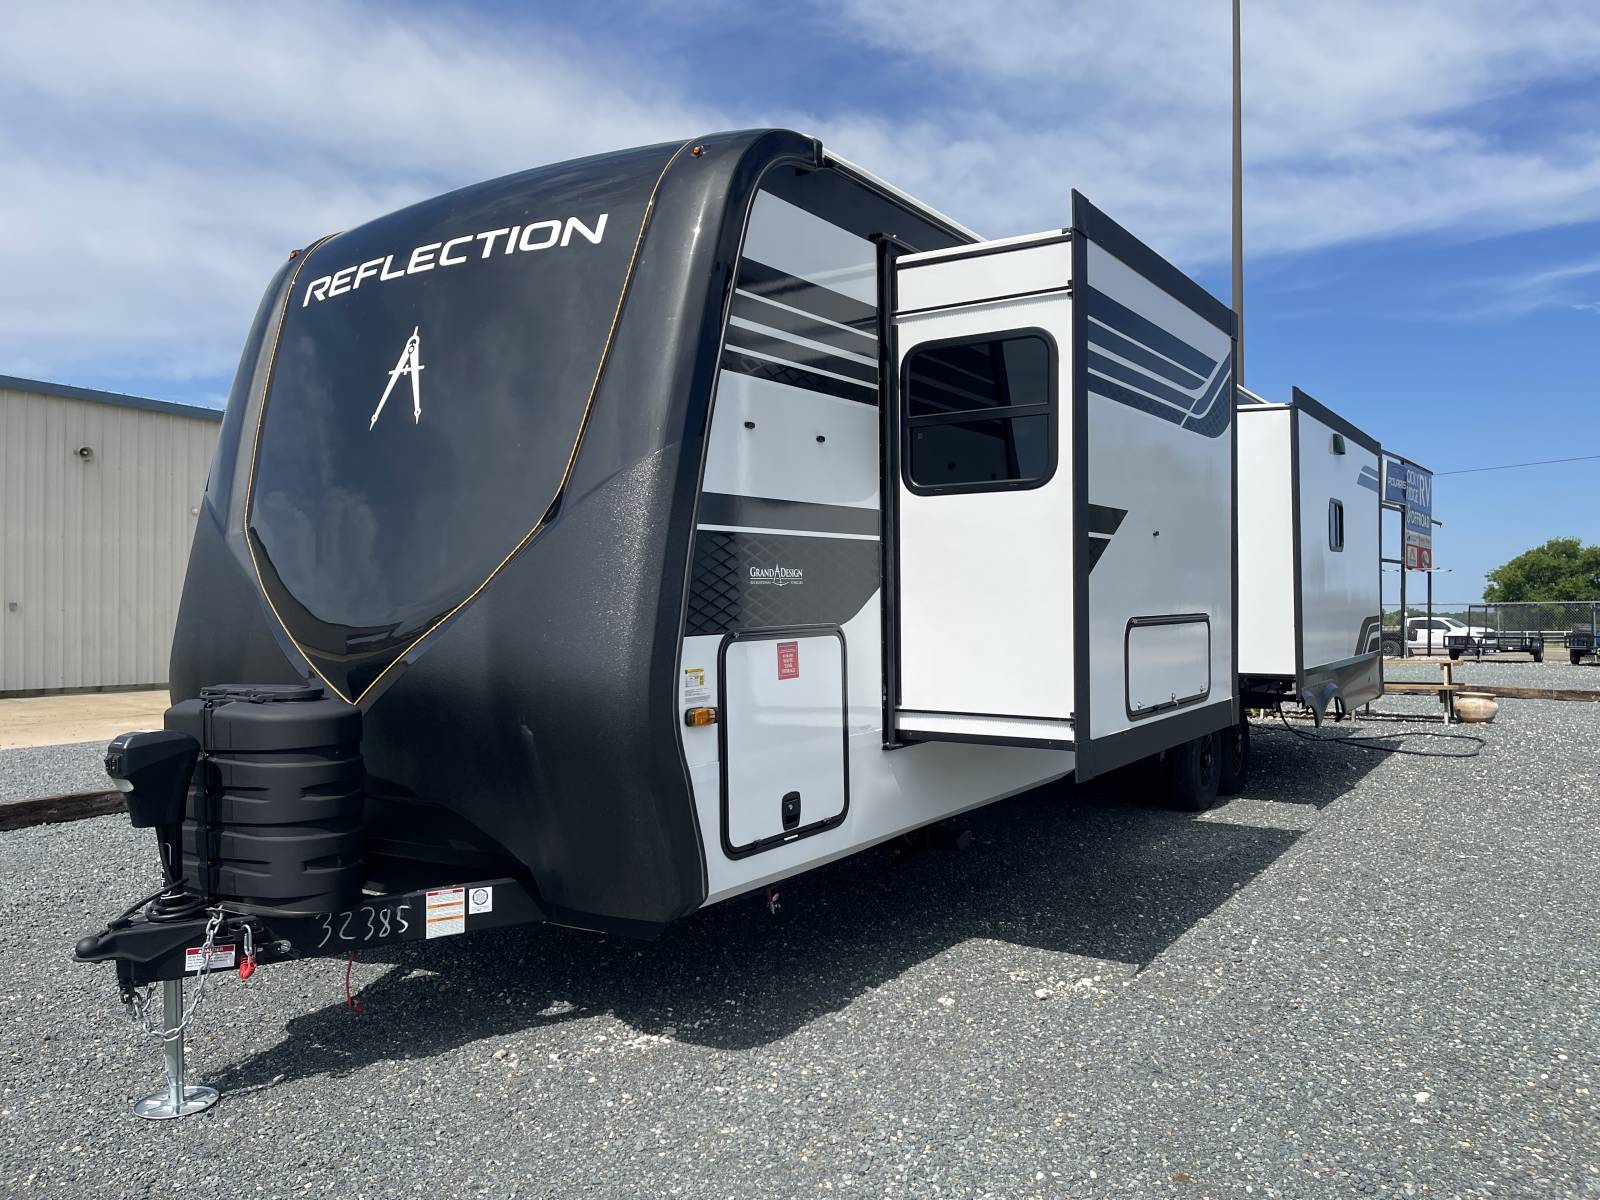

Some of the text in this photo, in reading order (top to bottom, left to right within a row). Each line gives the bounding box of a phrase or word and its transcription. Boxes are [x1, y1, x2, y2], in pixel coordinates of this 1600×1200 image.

[302, 213, 609, 308] REFLECTION
[1419, 475, 1431, 508] RV
[750, 566, 803, 578] GRAND DESIGN
[315, 905, 411, 948] 32385
